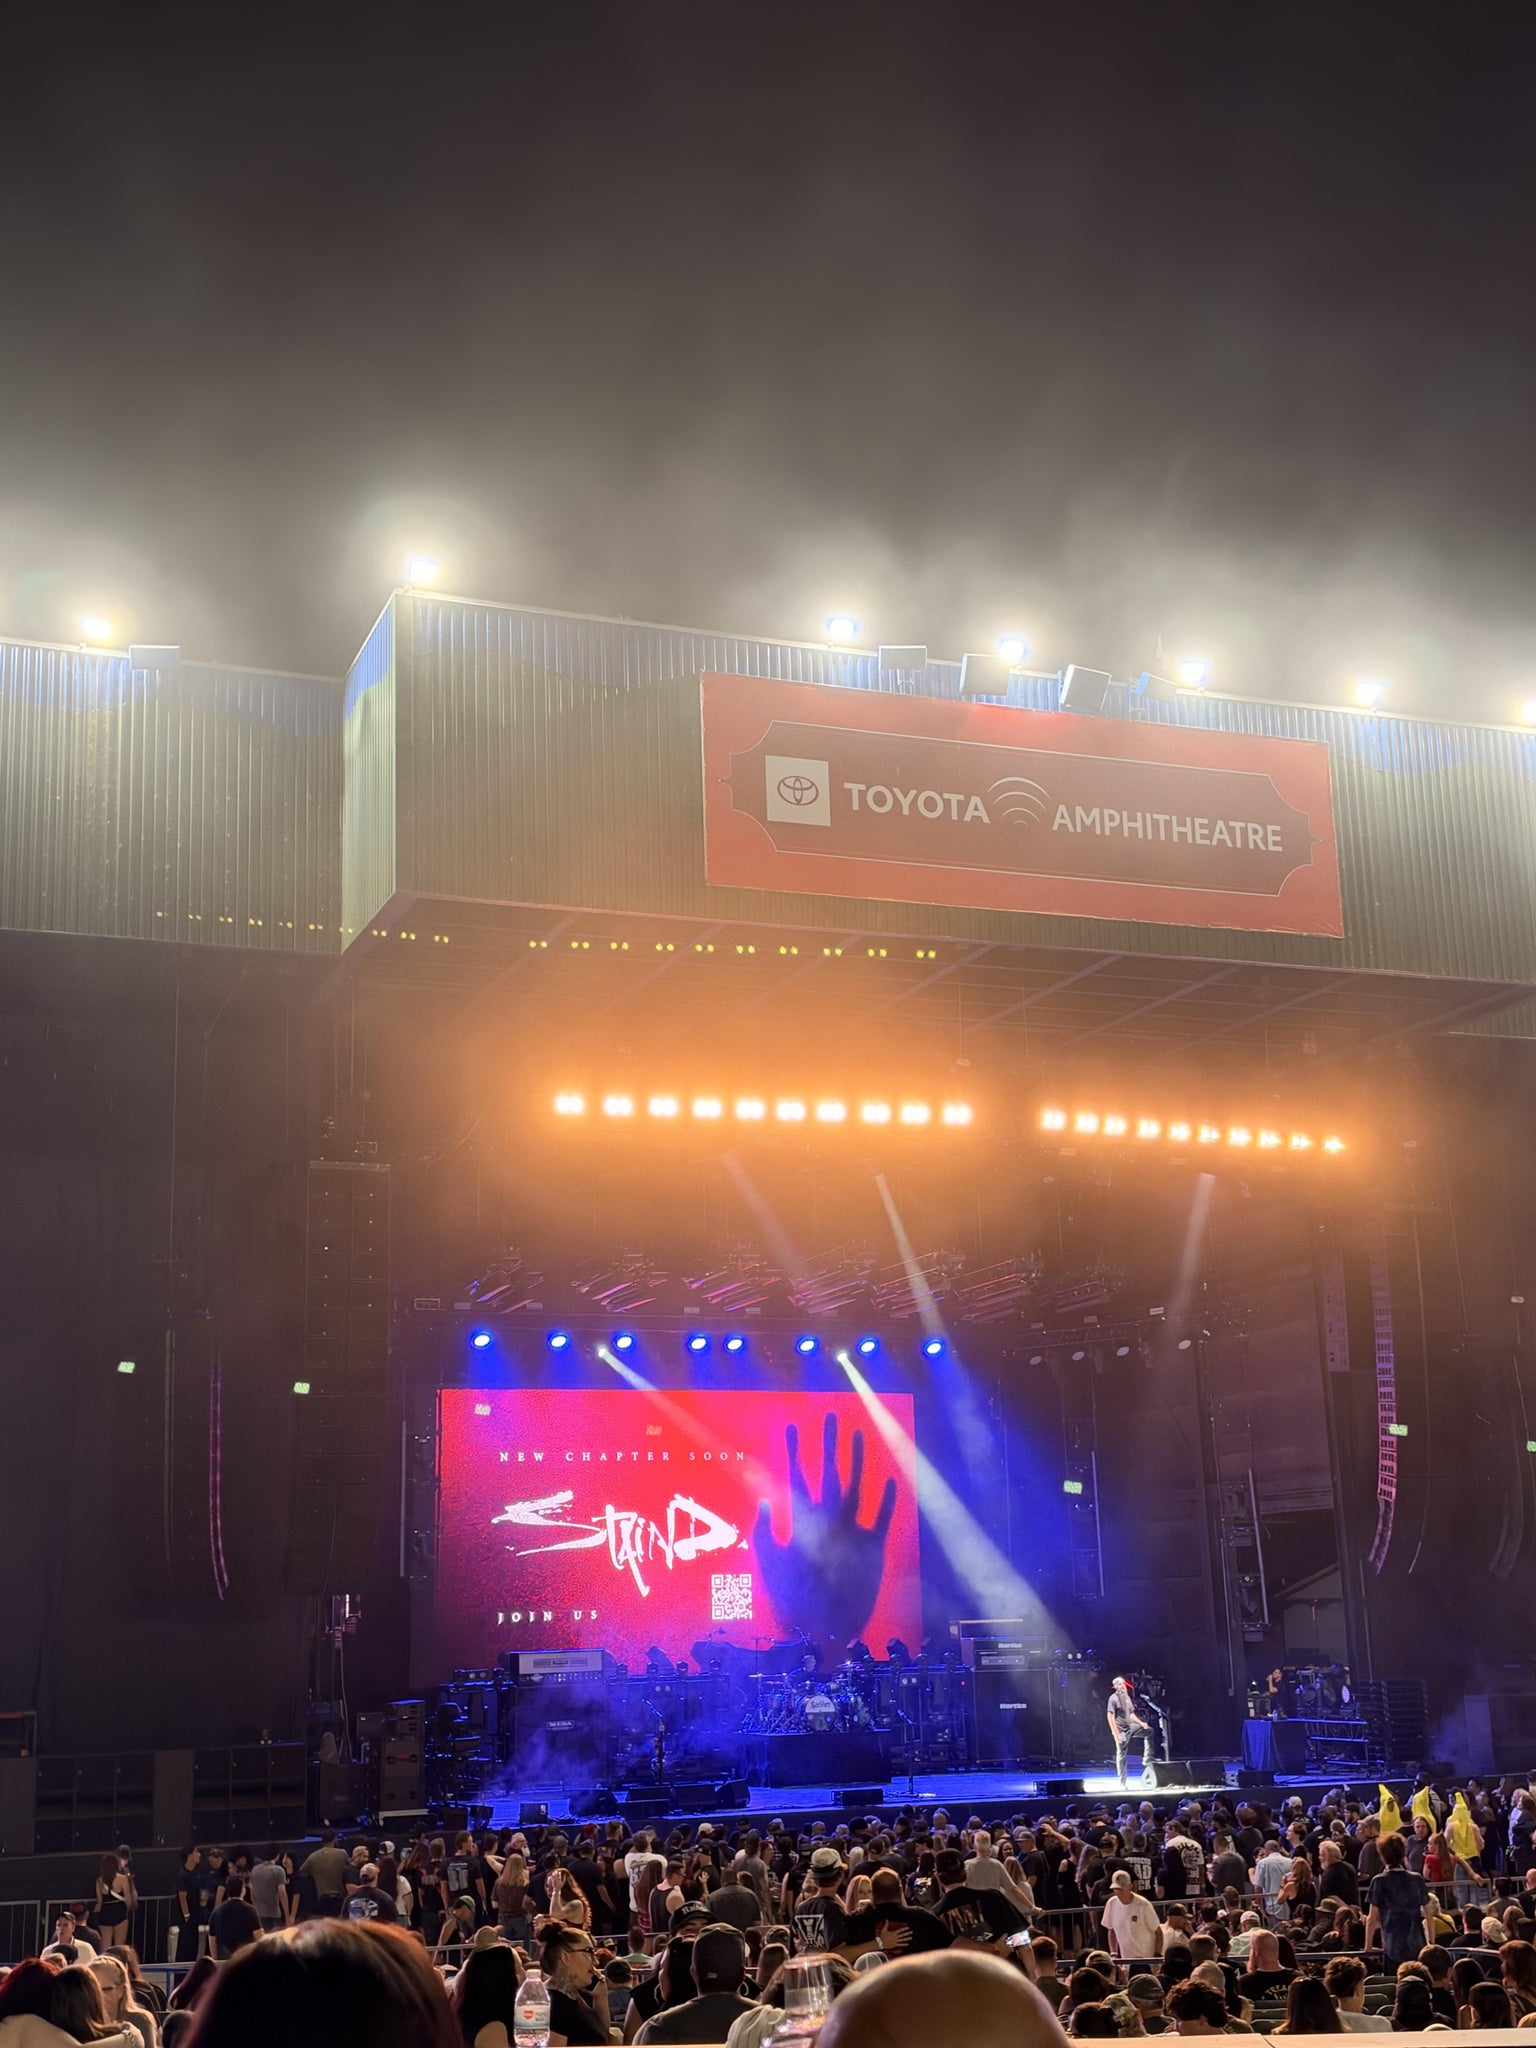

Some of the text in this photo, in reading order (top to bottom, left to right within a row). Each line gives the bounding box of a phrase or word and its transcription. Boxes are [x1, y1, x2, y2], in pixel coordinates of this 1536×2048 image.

[844, 782, 1283, 852] TOYOTA AMPHITHEATRE
[500, 1451, 745, 1462] NEW CHAPTER SOON
[497, 1609, 598, 1625] JOIN US
